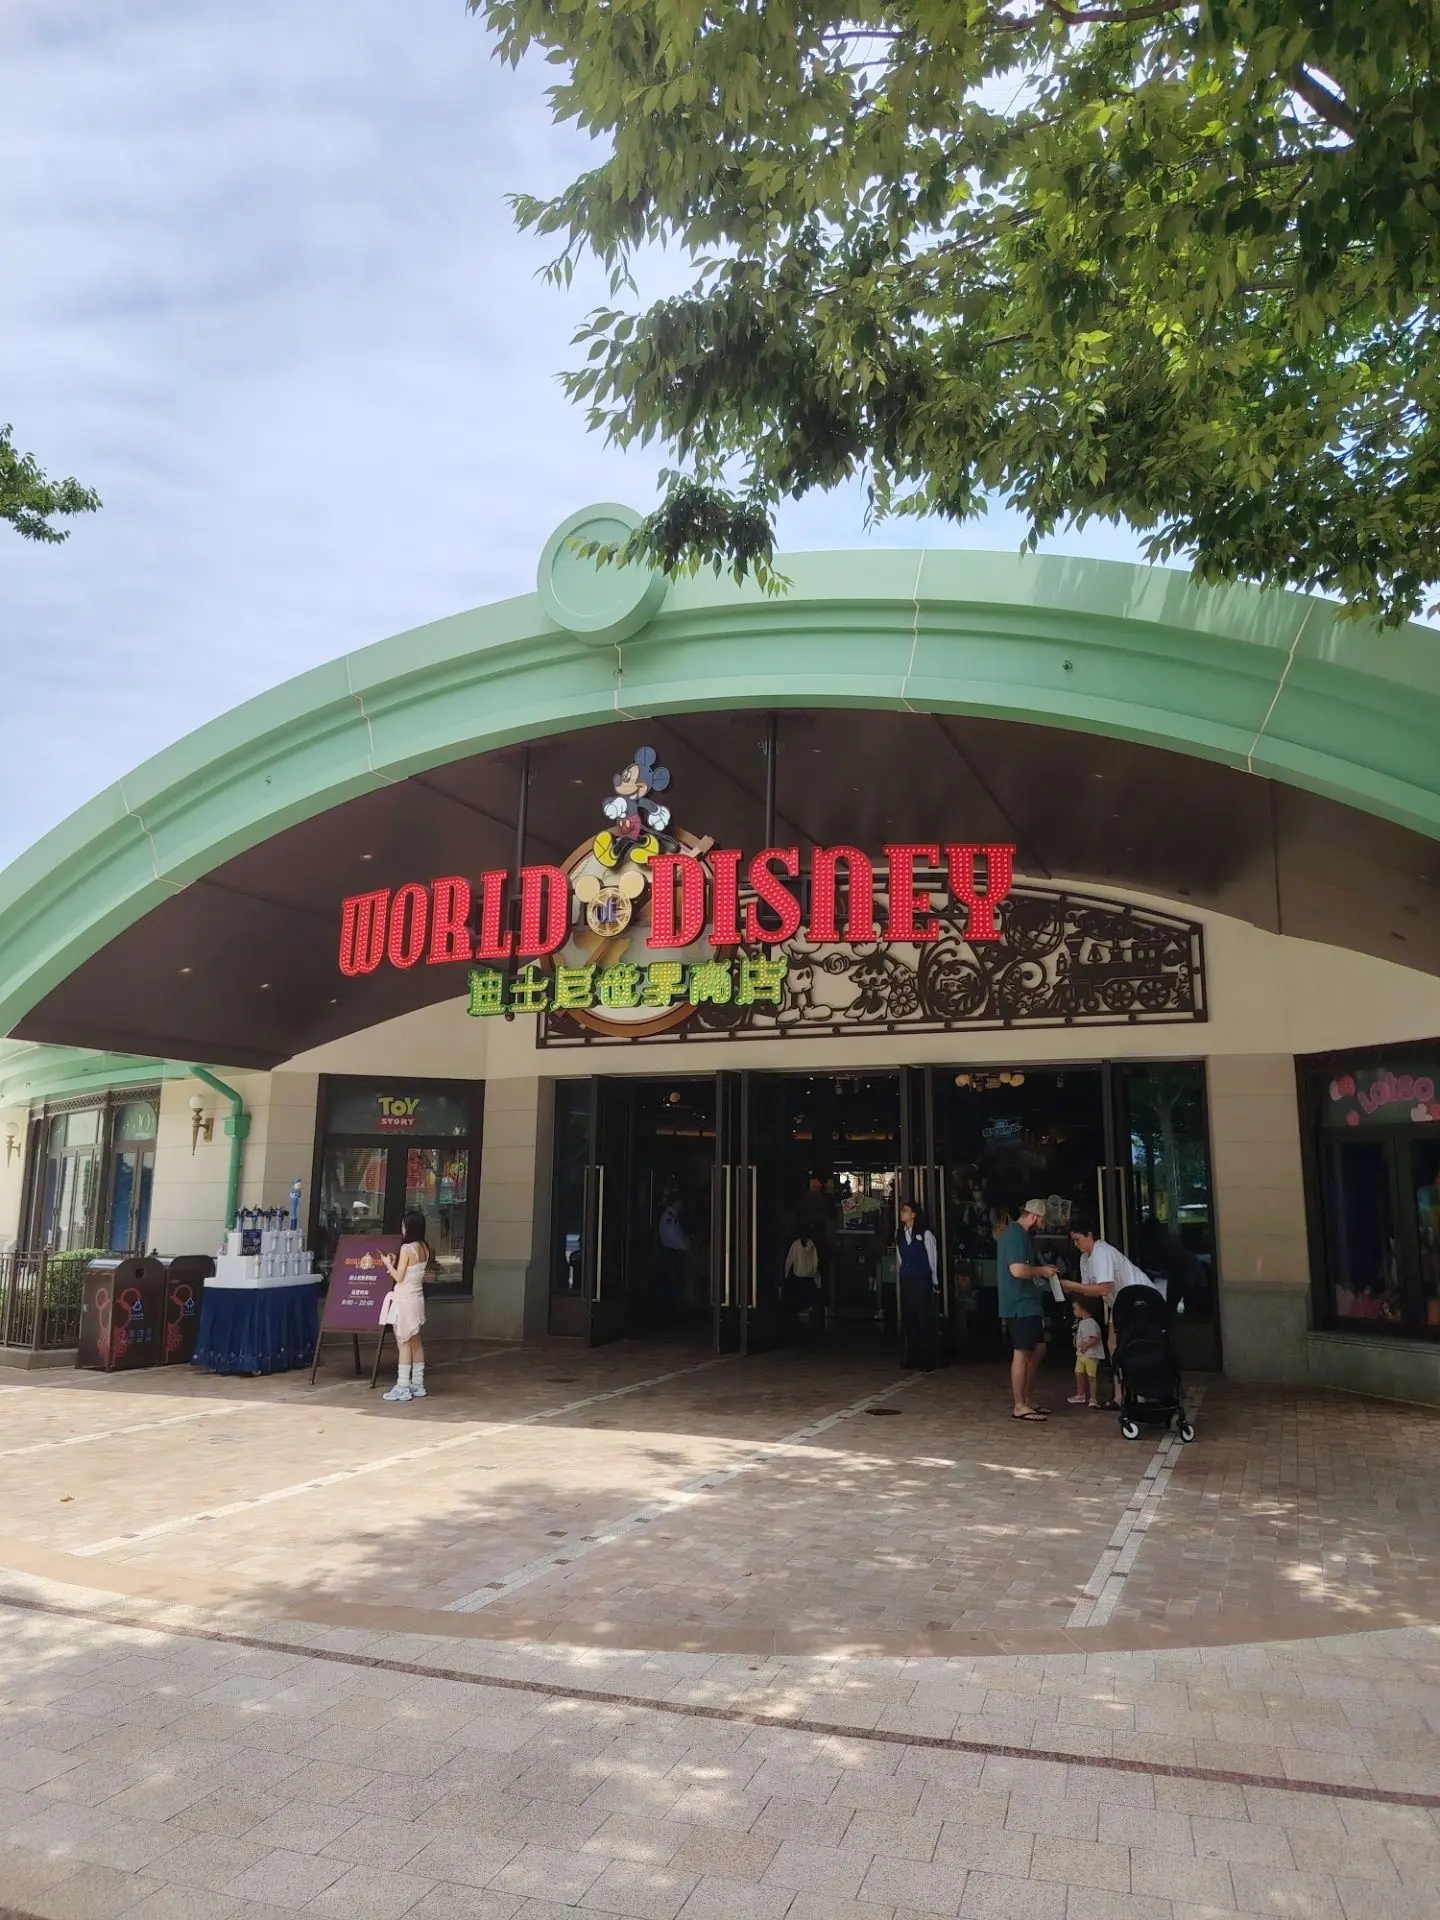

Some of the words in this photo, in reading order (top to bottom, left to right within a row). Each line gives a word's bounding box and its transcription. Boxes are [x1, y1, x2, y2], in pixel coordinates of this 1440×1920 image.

[339, 864, 569, 977] WORLD
[646, 843, 1017, 949] DISNEY
[467, 953, 788, 1017] 迪士尼世界商店
[377, 1096, 420, 1117] TOY
[381, 1117, 415, 1126] STORY
